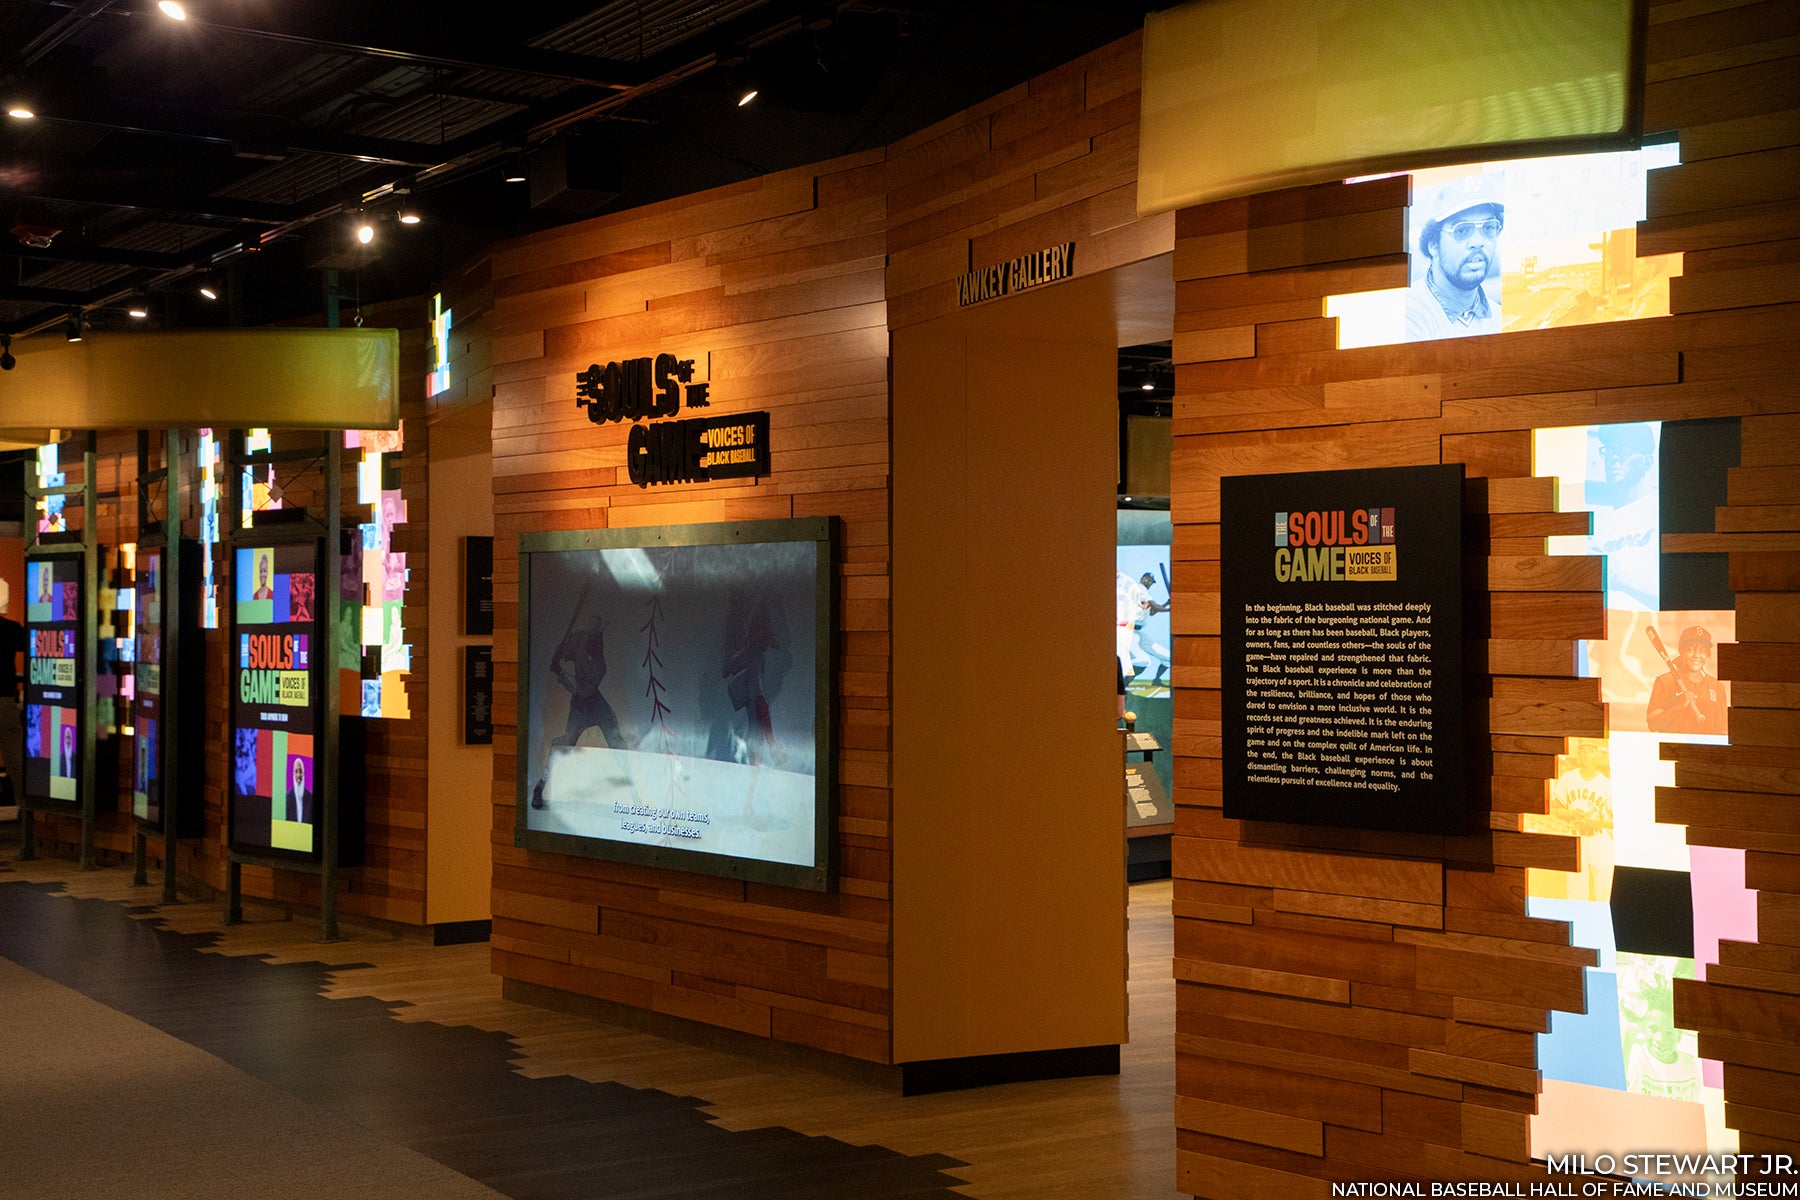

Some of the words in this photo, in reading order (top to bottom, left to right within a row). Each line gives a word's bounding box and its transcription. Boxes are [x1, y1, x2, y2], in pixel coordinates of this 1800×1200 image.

[957, 262, 1006, 306] YAWKEY
[1010, 242, 1072, 291] GALLERY
[678, 359, 695, 383] OF
[588, 353, 680, 425] SOULS
[685, 383, 710, 408] THE
[708, 425, 744, 448] VOICES
[745, 424, 755, 444] OF
[628, 418, 709, 489] GAME
[707, 449, 730, 466] BLACK
[730, 447, 756, 464] BASEBALL
[1276, 521, 1288, 536] THE
[1289, 509, 1369, 547] SOULS
[1370, 514, 1378, 527] OF
[1382, 525, 1394, 538] THE
[1275, 547, 1345, 583] GAME
[1349, 552, 1381, 565] VOICES
[1383, 552, 1392, 564] OF
[1349, 566, 1370, 575] BLACK
[1370, 566, 1392, 574] BASEBALL
[1253, 604, 1266, 612] the
[1267, 603, 1303, 614] beginning,
[1304, 603, 1324, 612] Black
[1325, 603, 1355, 611] baseball
[1373, 602, 1403, 611] stitched
[1405, 602, 1431, 613] deeply
[1245, 616, 1260, 624] into
[1260, 616, 1272, 624] the
[1273, 615, 1293, 624] fabric
[1304, 616, 1316, 624] the
[1317, 615, 1358, 626] burgeoning
[1359, 615, 1390, 624] national
[1391, 617, 1414, 626] game.
[1416, 615, 1431, 624] And
[1245, 628, 1256, 636] for
[1266, 628, 1282, 638] long
[1292, 628, 1311, 636] there
[1312, 628, 1325, 636] has
[1326, 628, 1344, 636] been
[1345, 628, 1378, 637] baseball,
[1379, 628, 1400, 637] Black
[1401, 628, 1431, 639] players,
[249, 634, 293, 670] SOULS
[1245, 641, 1272, 649] owners,
[1273, 640, 1290, 649] fans,
[1292, 640, 1305, 649] and
[1306, 640, 1340, 649] countless
[1386, 641, 1406, 650] souls
[1407, 641, 1417, 650] of
[1418, 641, 1432, 650] the
[1289, 652, 1319, 663] repaired
[1321, 653, 1335, 662] and
[1337, 653, 1386, 664] strengthened
[1388, 654, 1404, 662] that
[1407, 654, 1431, 663] fabric.
[1246, 664, 1259, 673] The
[1262, 665, 1281, 673] Black
[1285, 665, 1314, 674] baseball
[1318, 665, 1357, 676] experience
[1396, 667, 1414, 676] than
[1418, 667, 1432, 676] the
[240, 669, 280, 704] GAME
[1246, 676, 1279, 687] trajectory
[1292, 679, 1313, 688] sport.
[1332, 678, 1365, 687] chronicle
[1365, 679, 1380, 688] and
[1380, 679, 1422, 689] celebration
[1246, 689, 1258, 697] the
[1260, 689, 1295, 699] resilience,
[1298, 690, 1334, 700] brilliance,
[1337, 691, 1350, 700] and
[1353, 691, 1376, 702] hopes
[1379, 692, 1388, 701] of
[1391, 692, 1412, 701] those
[1415, 693, 1432, 702] who
[1246, 701, 1266, 709] dared
[1278, 701, 1307, 711] envision
[1338, 703, 1371, 713] inclusive
[1373, 705, 1397, 714] world.
[1419, 706, 1432, 715] the
[1246, 713, 1271, 722] records
[1284, 714, 1297, 723] and
[1298, 716, 1332, 726] greatness
[1333, 716, 1367, 725] achieved.
[1384, 718, 1397, 726] the
[1398, 718, 1433, 730] enduring
[1246, 725, 1265, 736] spirit
[1275, 728, 1305, 738] progress
[1307, 727, 1320, 736] and
[1322, 728, 1334, 737] the
[1336, 729, 1368, 738] indelible
[1370, 730, 1389, 739] mark
[1391, 731, 1405, 740] left
[1419, 732, 1432, 741] the
[1247, 739, 1265, 748] game
[1267, 738, 1280, 747] and
[1293, 739, 1306, 748] the
[1307, 740, 1337, 751] complex
[1339, 741, 1357, 752] quilt
[1369, 743, 1405, 753] American
[1407, 744, 1422, 753] life.
[1247, 749, 1258, 758] the
[1262, 750, 1278, 760] end,
[1281, 751, 1293, 760] the
[1297, 752, 1316, 761] Black
[1320, 753, 1351, 763] baseball
[1354, 755, 1395, 767] experience
[1411, 757, 1433, 767] about
[1247, 761, 1287, 774] dismantling
[1291, 764, 1320, 774] barriers,
[1324, 766, 1366, 778] challenging
[1371, 770, 1396, 778] norms,
[1401, 770, 1415, 779] and
[1420, 771, 1433, 780] the
[1247, 774, 1280, 784] relentless
[1281, 776, 1306, 787] pursuit
[1315, 778, 1352, 788] excellence
[1353, 780, 1367, 789] and
[1368, 781, 1400, 793] equality.
[614, 802, 629, 814] from
[630, 805, 657, 820] creating
[658, 808, 670, 819] our
[671, 809, 685, 820] own
[687, 811, 710, 825] teams,
[621, 818, 647, 834] leagues,
[648, 822, 661, 834] and
[662, 823, 702, 839] businesses.
